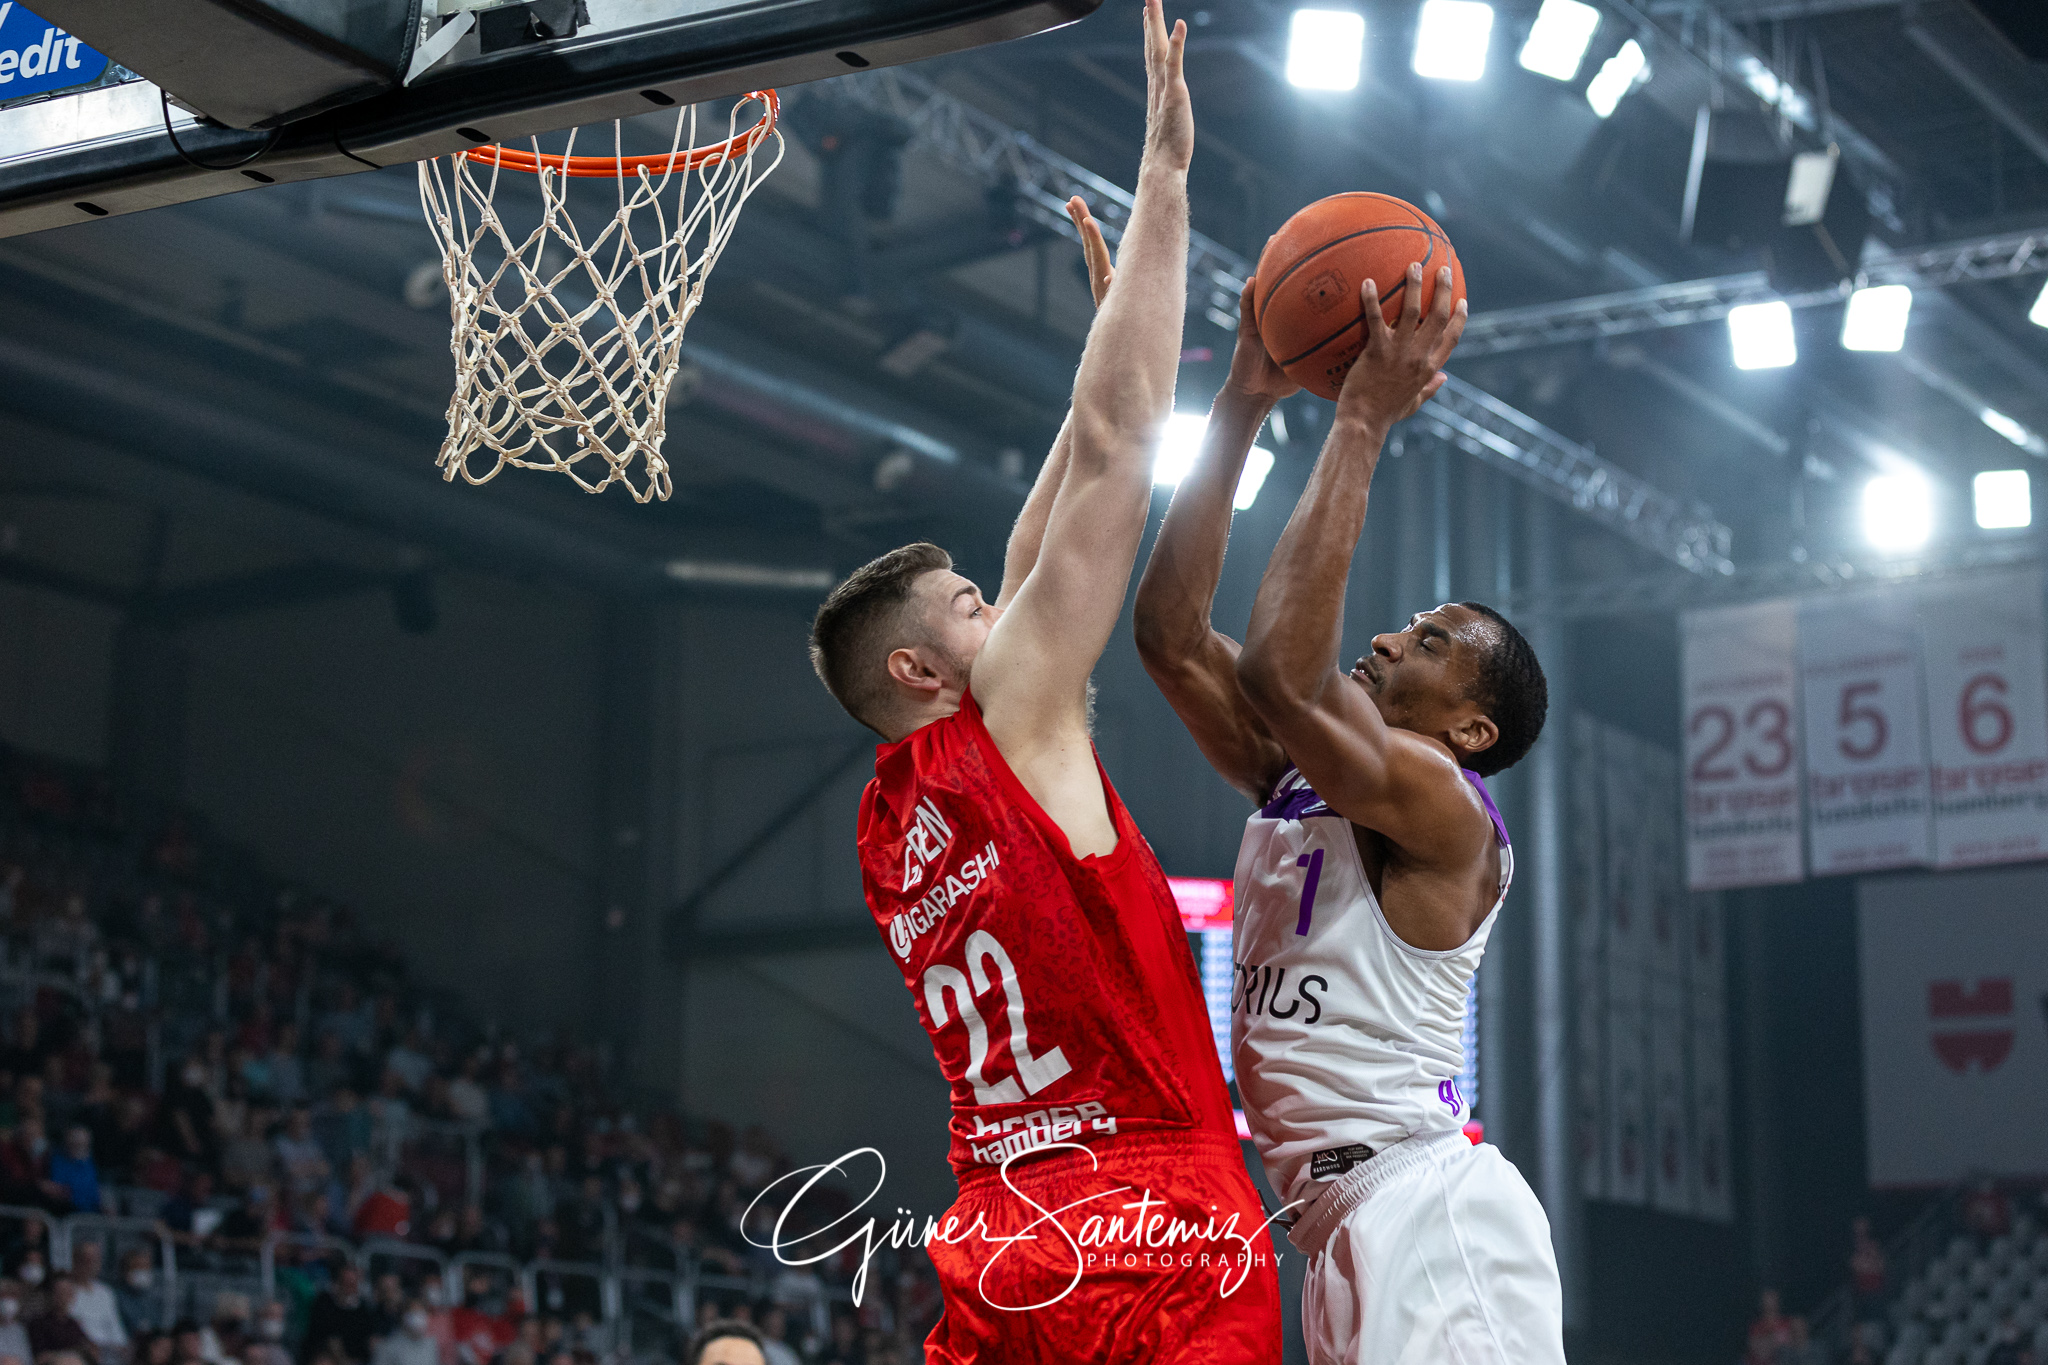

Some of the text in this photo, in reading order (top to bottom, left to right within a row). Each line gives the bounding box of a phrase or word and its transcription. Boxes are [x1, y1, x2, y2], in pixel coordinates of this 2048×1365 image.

[0, 27, 84, 84] edit
[1690, 697, 1794, 782] 23
[1837, 679, 1892, 762] 5
[1957, 671, 2016, 757] 6
[1295, 848, 1325, 937] 1
[923, 929, 1073, 1106] 22
